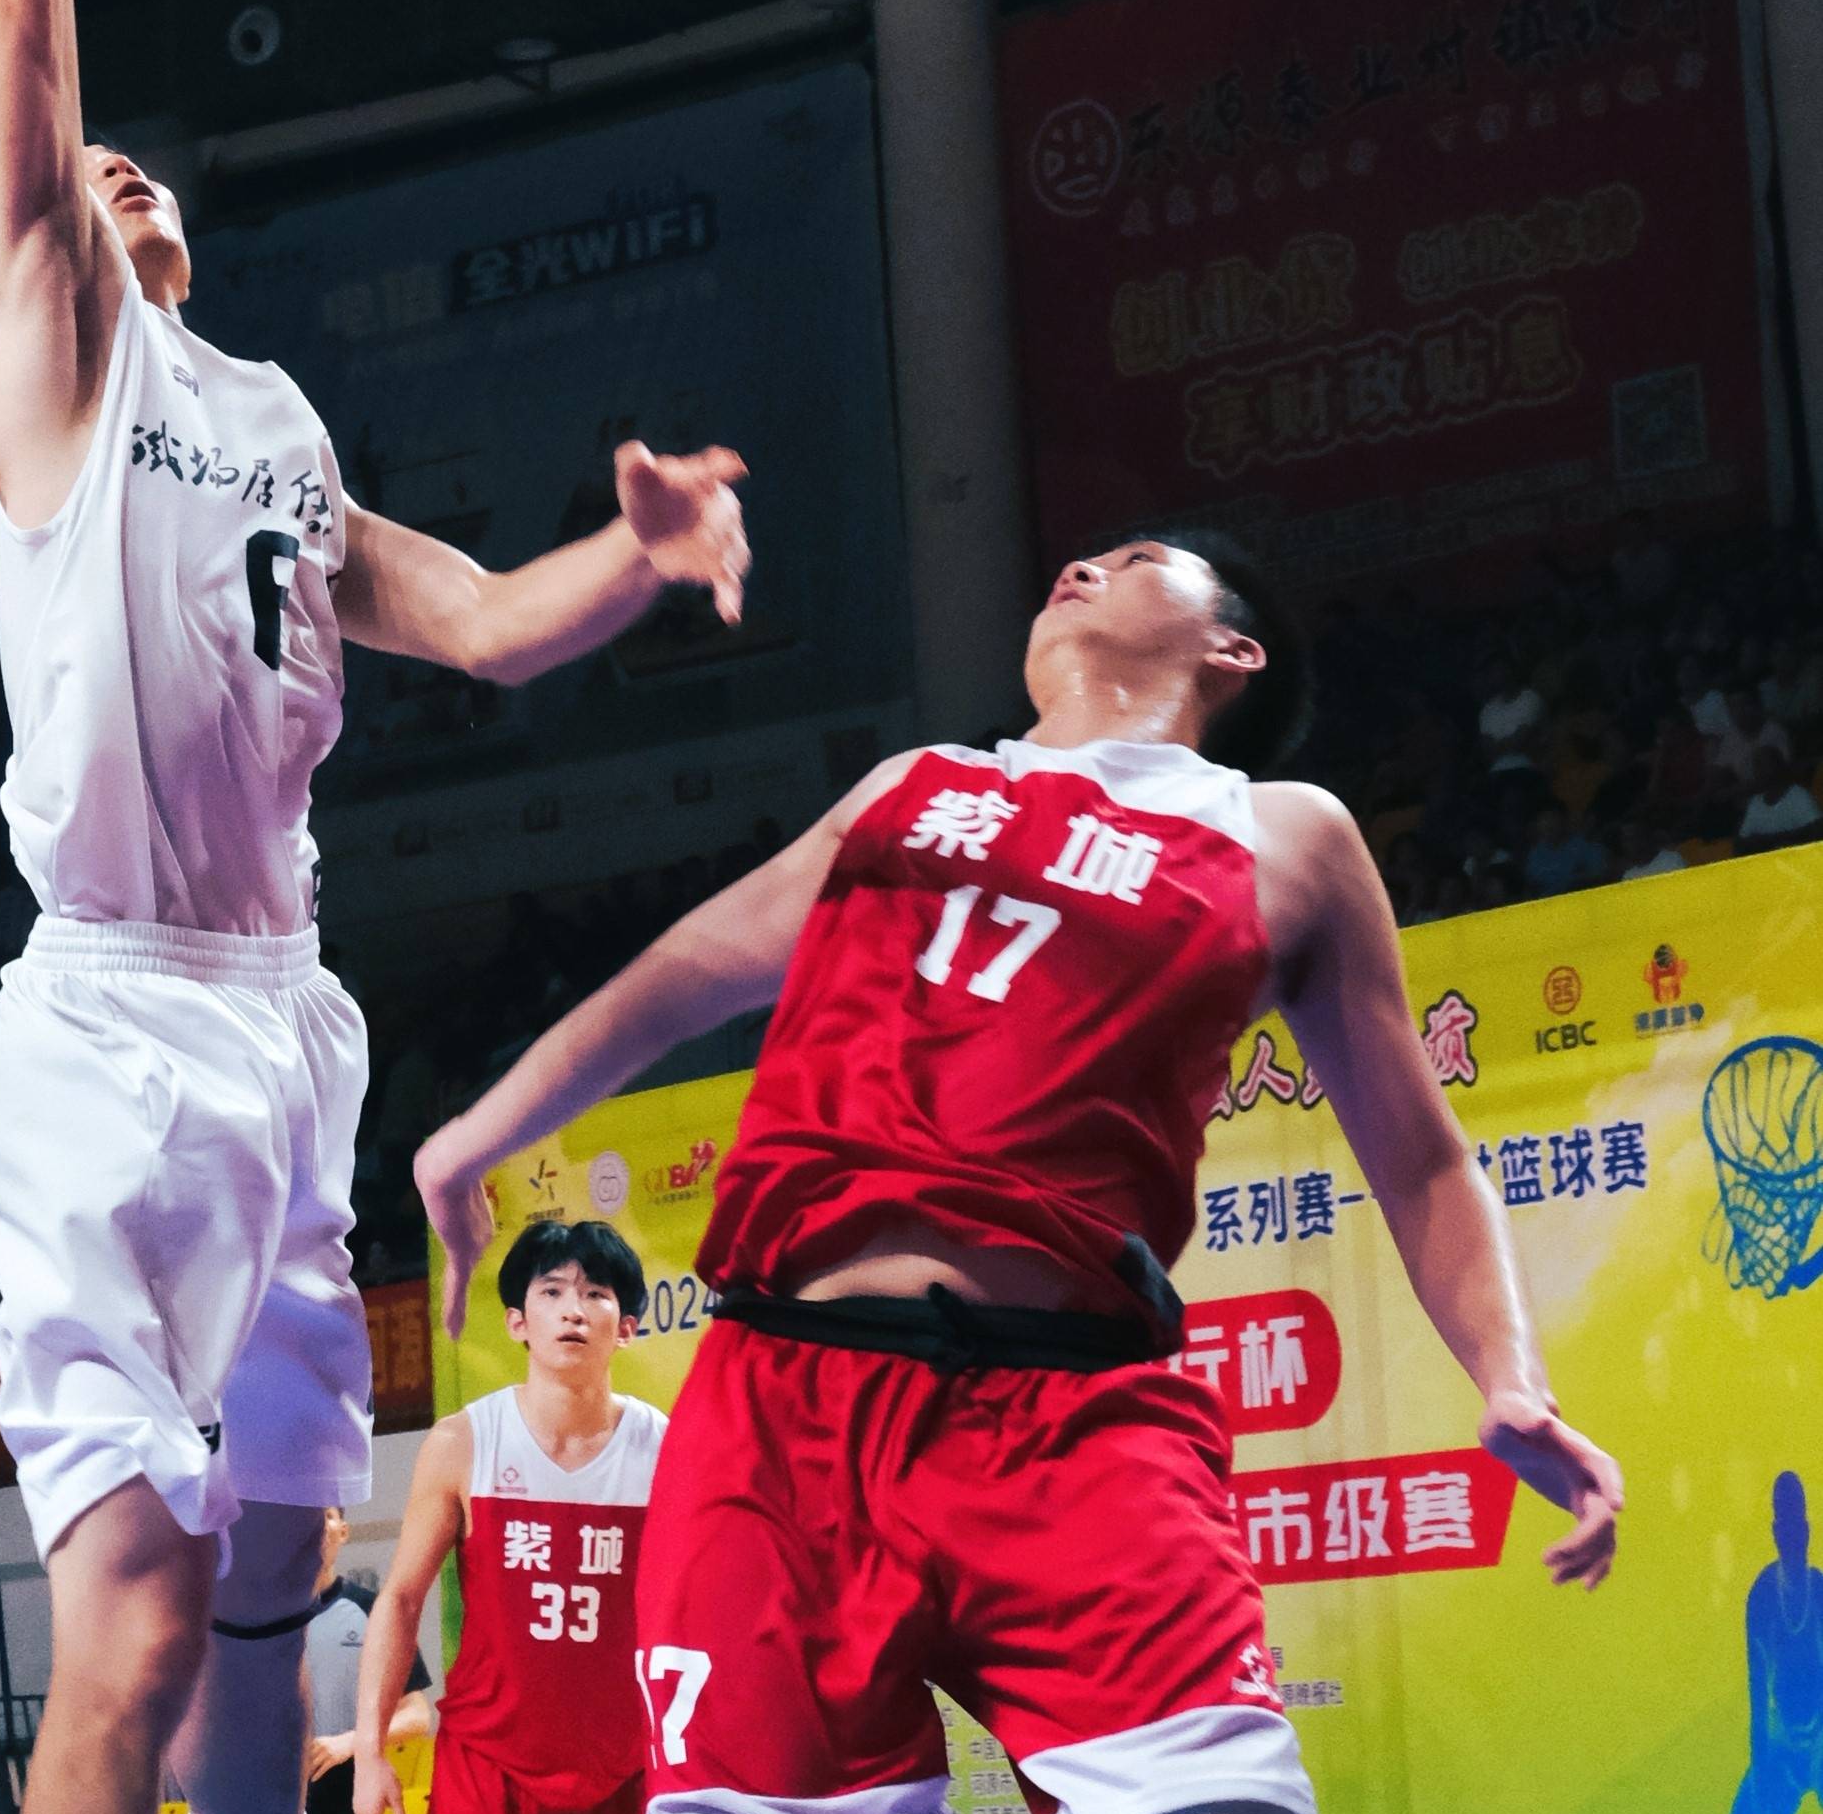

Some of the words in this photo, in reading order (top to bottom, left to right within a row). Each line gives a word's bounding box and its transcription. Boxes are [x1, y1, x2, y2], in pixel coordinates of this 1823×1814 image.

[903, 788, 1163, 906] 紫城
[916, 884, 1062, 1003] 17
[1535, 1020, 1597, 1054] ICBC
[503, 1519, 624, 1576] 紫城
[529, 1581, 601, 1643] 33
